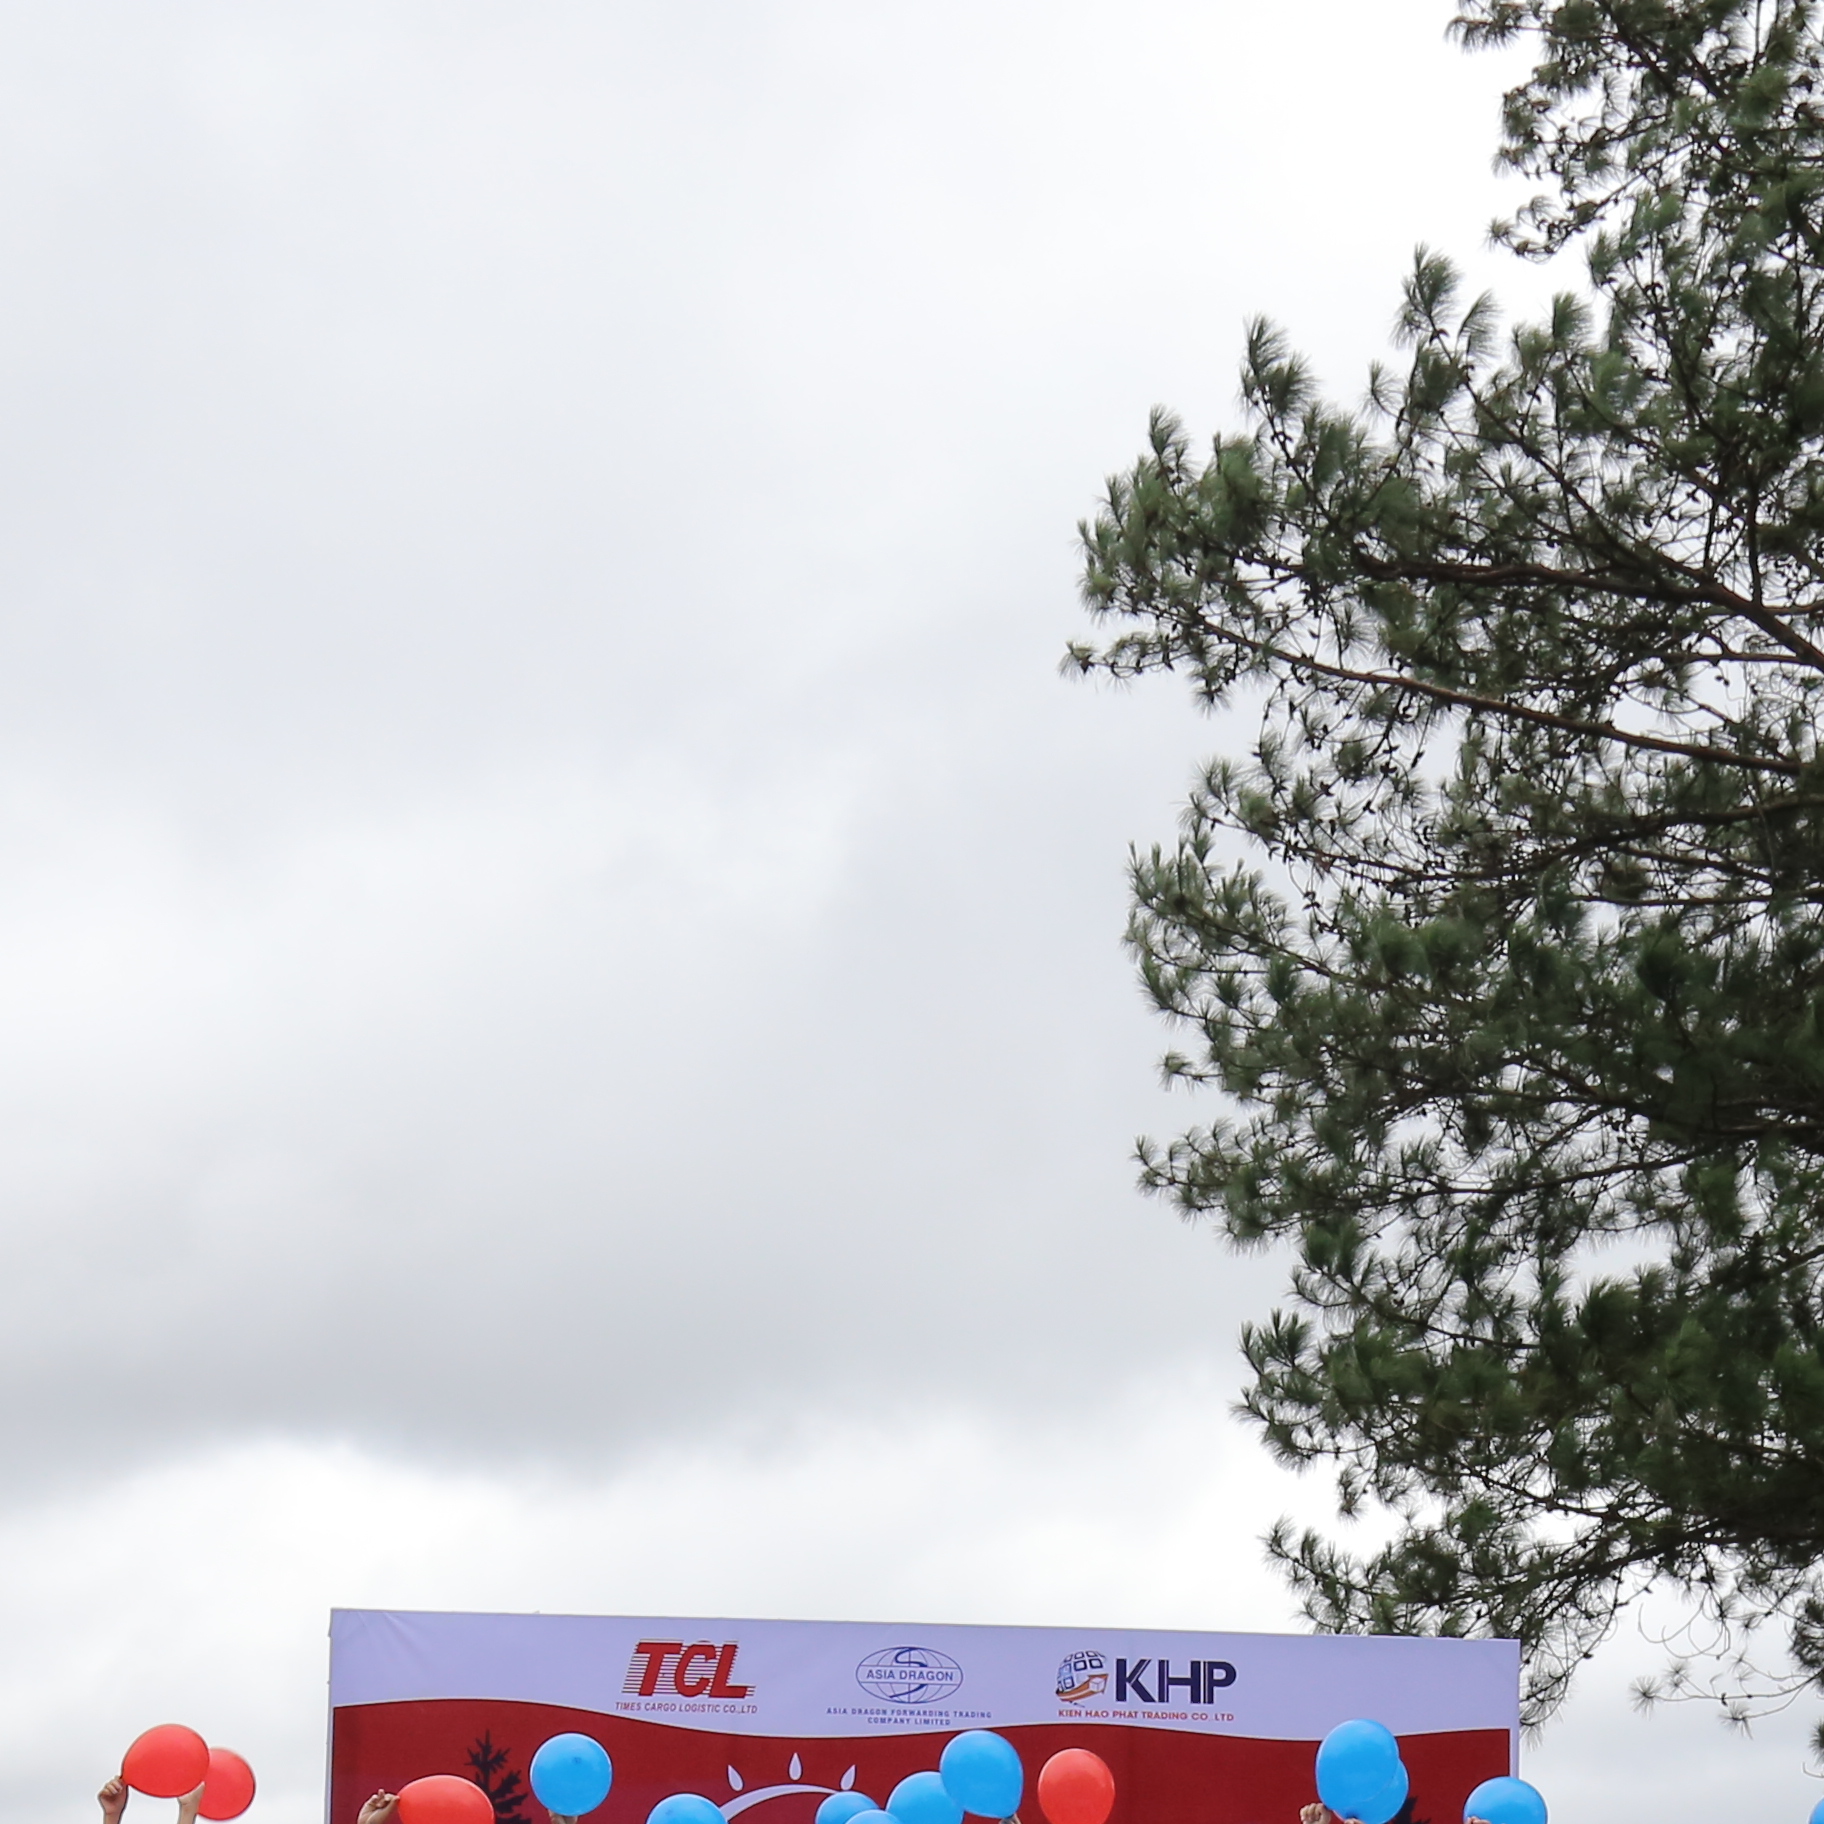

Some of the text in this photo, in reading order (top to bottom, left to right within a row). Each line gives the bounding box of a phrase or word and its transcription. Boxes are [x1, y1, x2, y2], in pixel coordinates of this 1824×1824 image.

[626, 1640, 754, 1698] TCL
[866, 1669, 953, 1681] ASIA DRAGON
[1115, 1657, 1237, 1704] KHP
[615, 1702, 641, 1711] TIMES
[644, 1702, 676, 1712] CARGO
[679, 1703, 720, 1713] LOGISTIC
[826, 1707, 992, 1718] ASIA DRAGON FORWARDING TRADING
[1058, 1709, 1082, 1717] KIEN
[1085, 1710, 1109, 1718] HAO
[1112, 1710, 1138, 1719] PHAT
[1141, 1711, 1188, 1720] TRADING
[868, 1716, 951, 1726] COMPANY LIMITED
